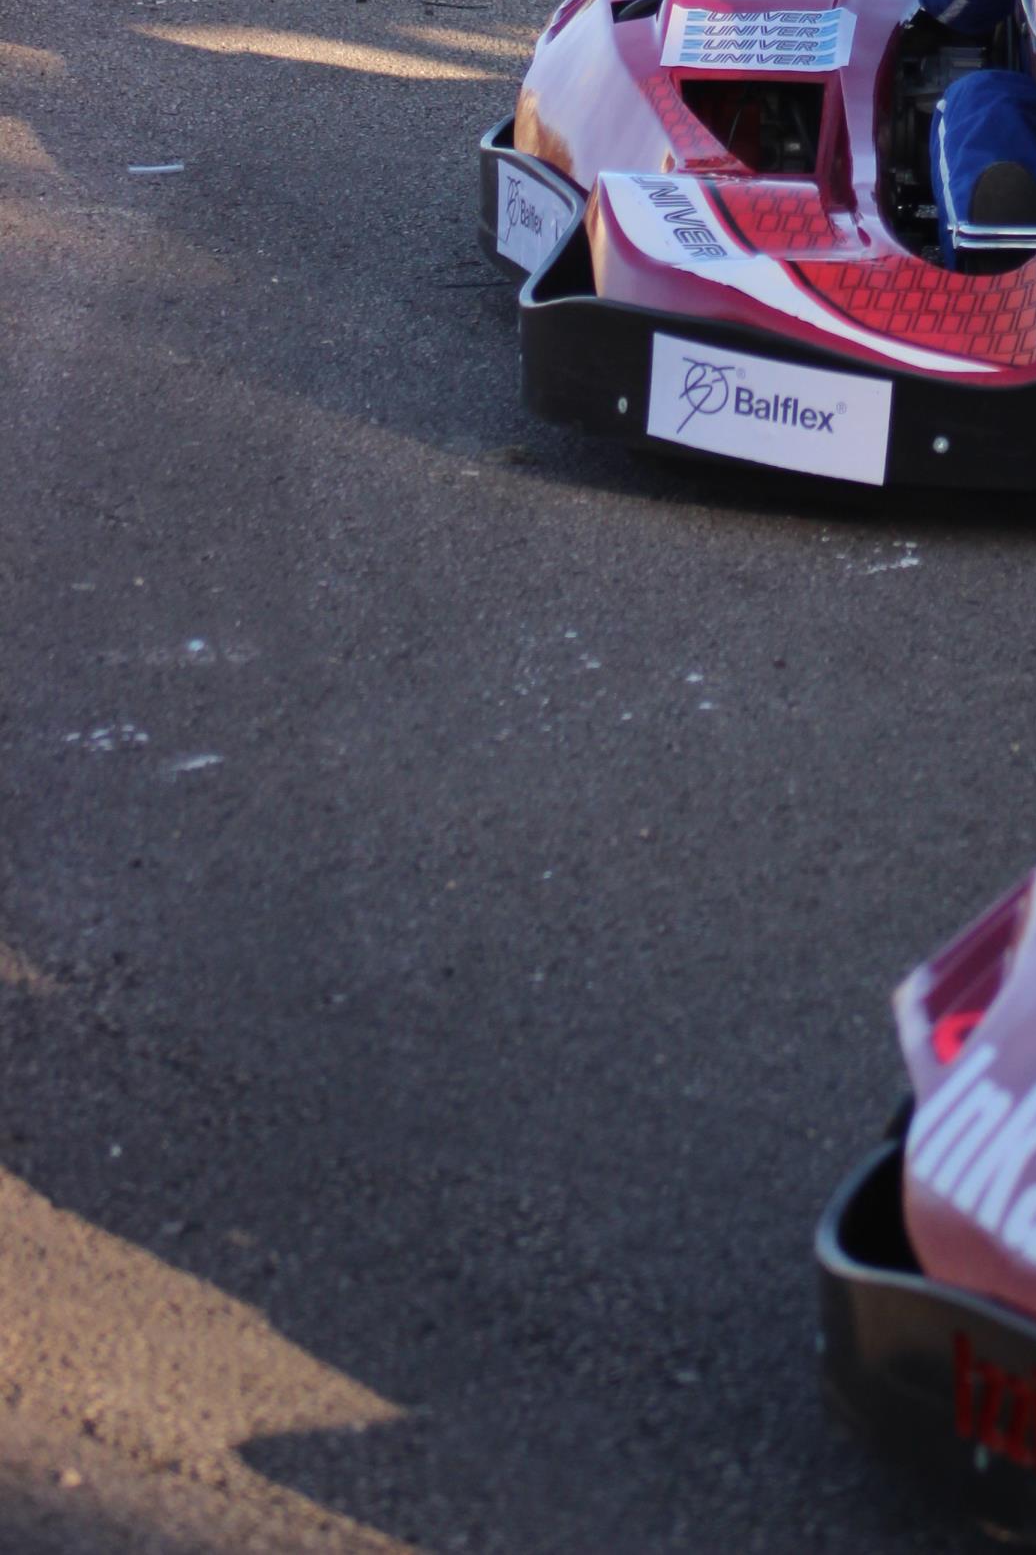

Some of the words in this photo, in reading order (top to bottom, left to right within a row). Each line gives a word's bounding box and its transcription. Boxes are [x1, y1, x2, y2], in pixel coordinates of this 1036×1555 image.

[707, 10, 822, 24] UNIVER
[703, 24, 820, 38] UNIVER
[702, 38, 818, 52] UNIVER
[700, 52, 816, 66] UNIVER
[734, 385, 836, 434] Balflex
